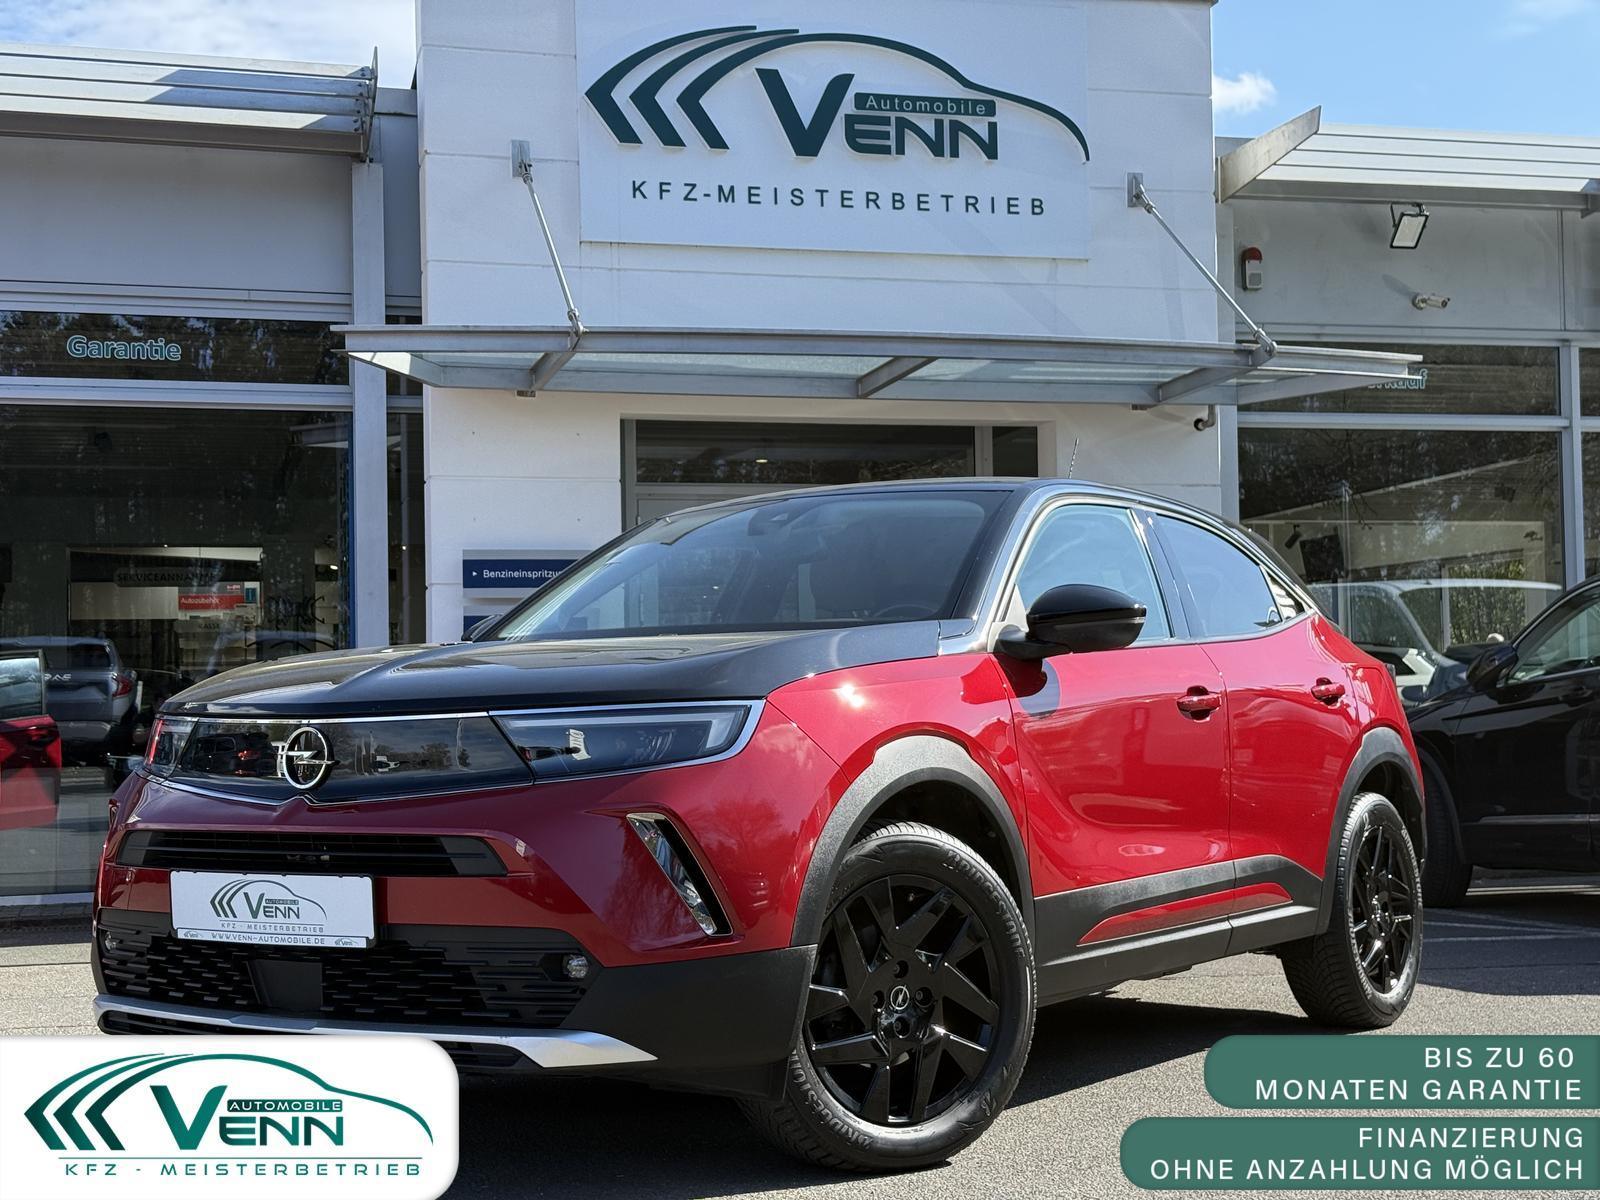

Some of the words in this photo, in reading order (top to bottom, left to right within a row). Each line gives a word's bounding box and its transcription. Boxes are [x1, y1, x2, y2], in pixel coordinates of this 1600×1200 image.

[755, 67, 999, 161] VENN
[865, 94, 987, 117] Automobile
[631, 180, 1046, 216] KFZ-MEISTERBETRIEB
[66, 334, 182, 361] Garantie
[243, 891, 300, 920] VENN
[247, 924, 324, 933] MEISTERBETRIEB
[790, 1048, 874, 1150] BRIDGESTON
